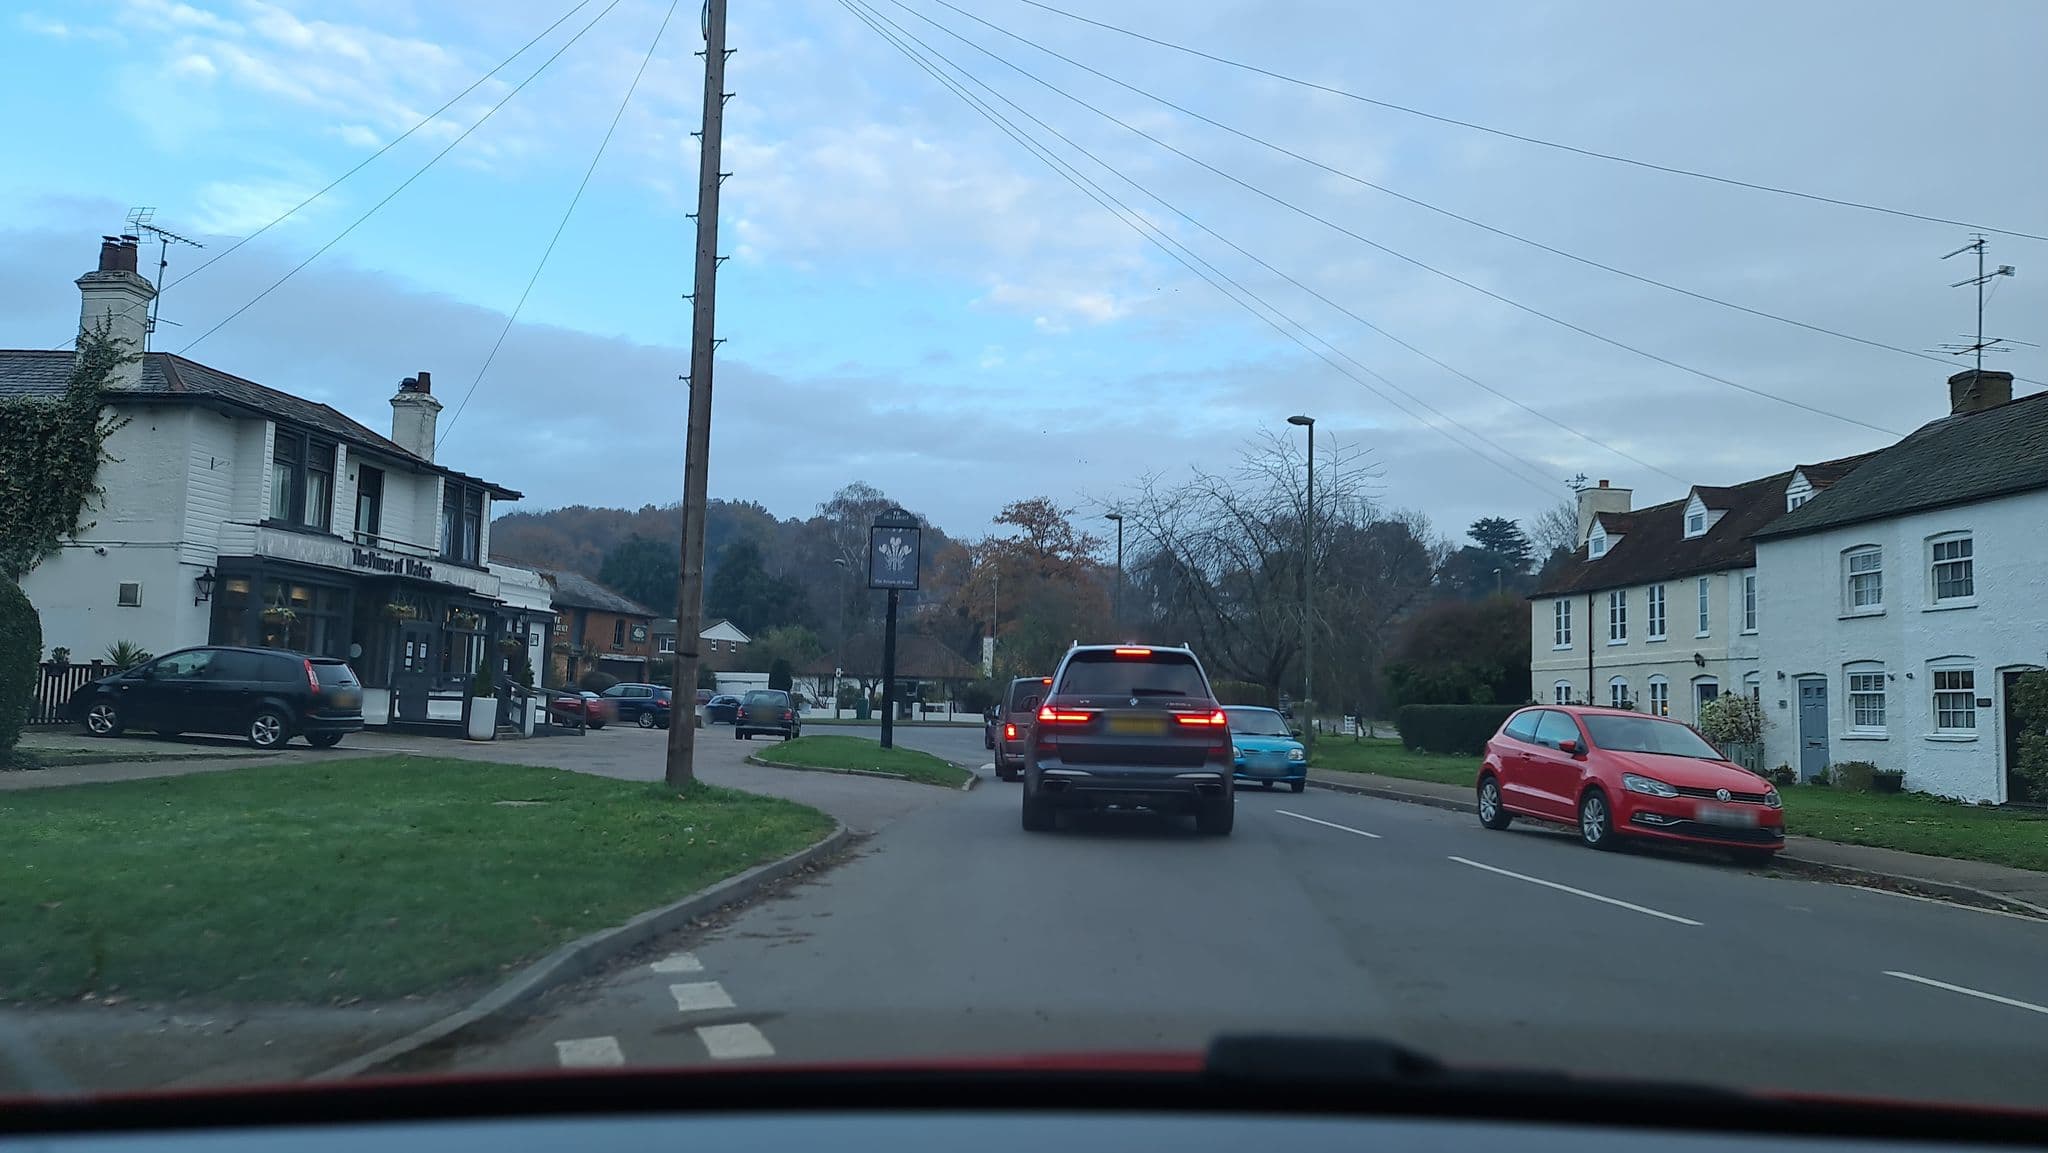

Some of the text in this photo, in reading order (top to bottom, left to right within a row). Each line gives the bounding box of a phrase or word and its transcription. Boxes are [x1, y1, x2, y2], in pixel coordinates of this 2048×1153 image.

[352, 548, 433, 579] The Prince of Wales
